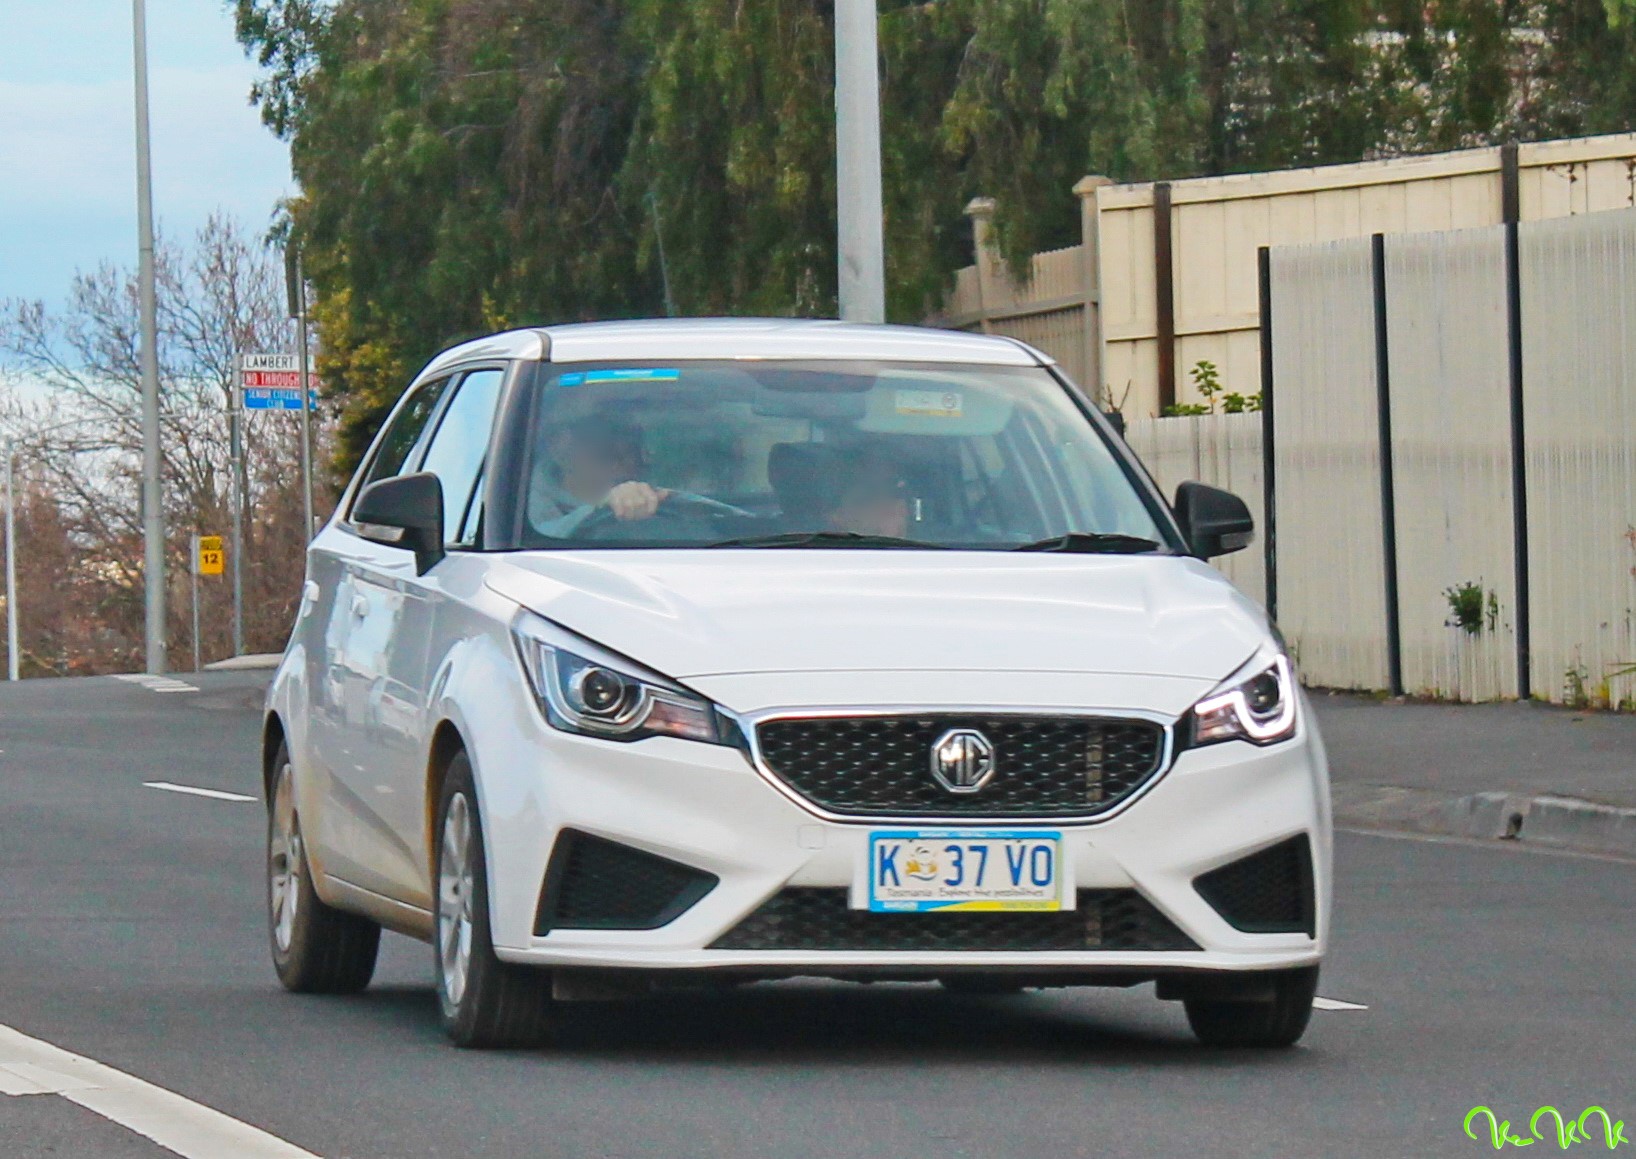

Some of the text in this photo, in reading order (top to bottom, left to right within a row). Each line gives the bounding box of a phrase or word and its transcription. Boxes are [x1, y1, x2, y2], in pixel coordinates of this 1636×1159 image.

[246, 356, 293, 368] LAMBERT
[246, 372, 258, 385] NO
[261, 372, 300, 386] THROUGH
[273, 389, 302, 400] CITIZEN
[203, 553, 218, 564] 12
[940, 735, 989, 785] MG
[879, 845, 901, 887] K
[944, 844, 988, 887] 37
[887, 888, 932, 897] Tasmania
[939, 887, 971, 898] Explore
